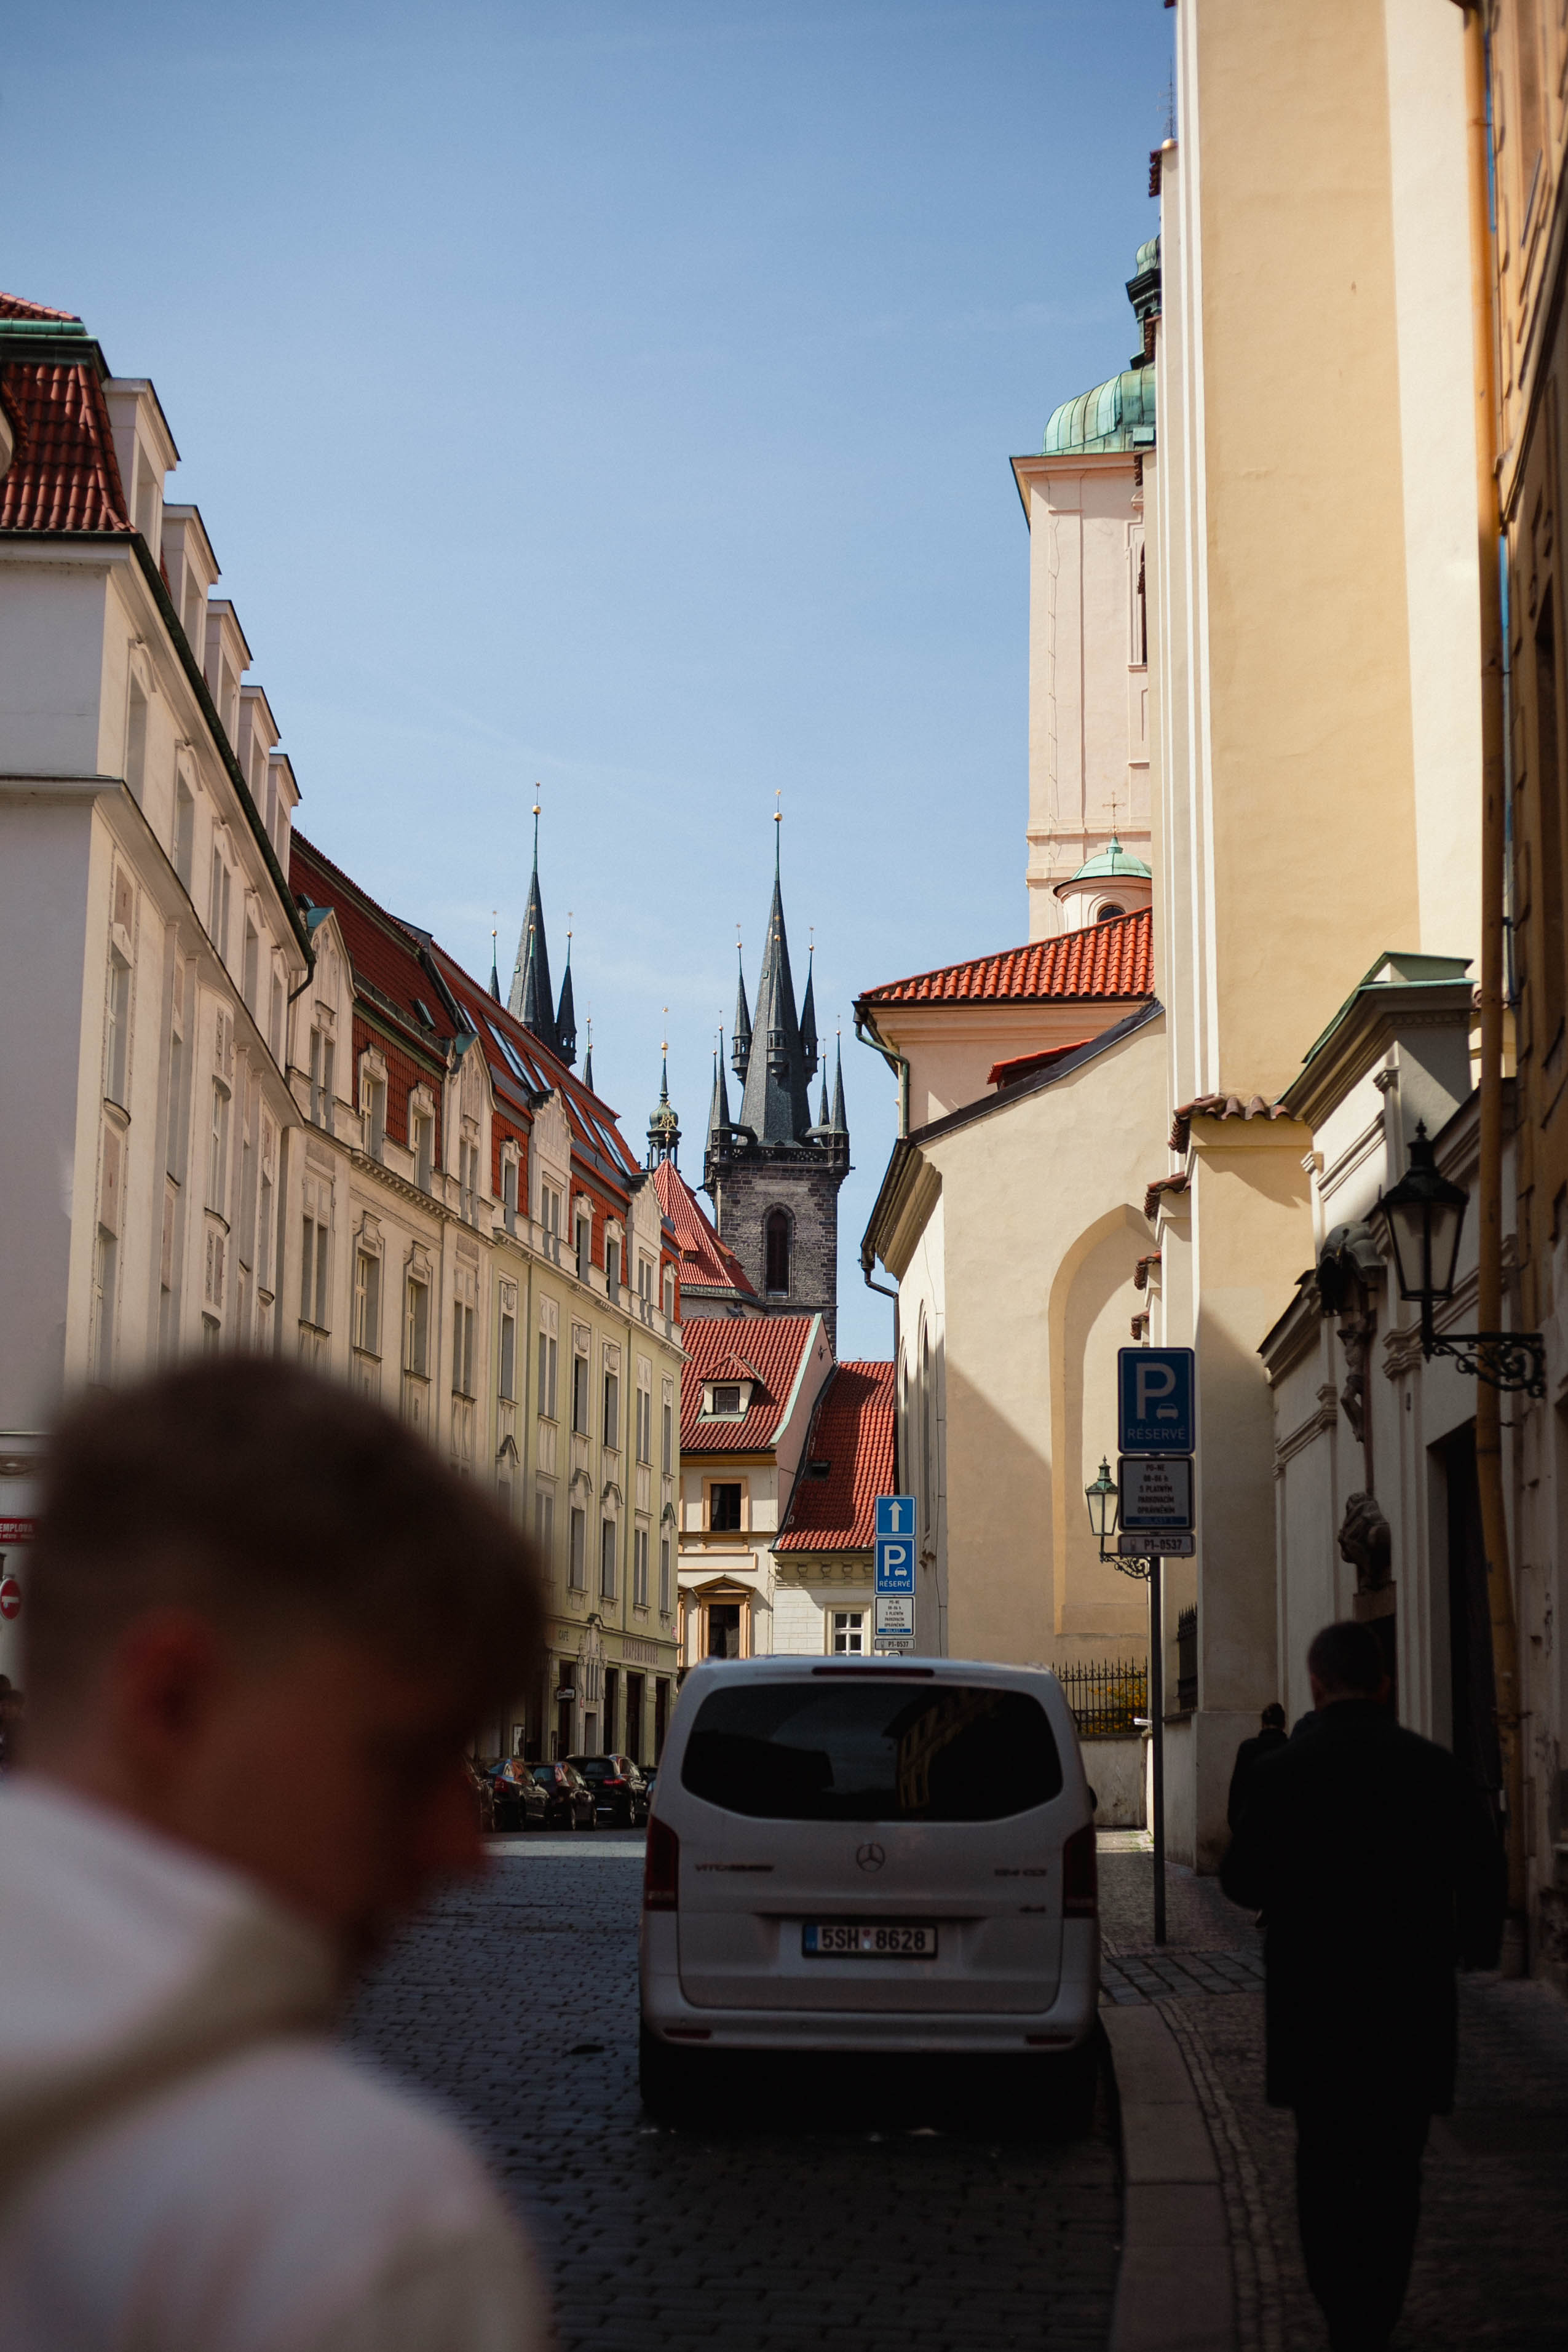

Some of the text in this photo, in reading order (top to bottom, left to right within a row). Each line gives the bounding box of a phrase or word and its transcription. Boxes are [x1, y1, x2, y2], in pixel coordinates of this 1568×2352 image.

[1136, 1363, 1176, 1420] P
[1127, 1424, 1186, 1440] RÉSERVÉ
[1144, 1539, 1182, 1550] P1-0537
[884, 1545, 906, 1577] P
[822, 1928, 925, 1950] 5SH 8628
